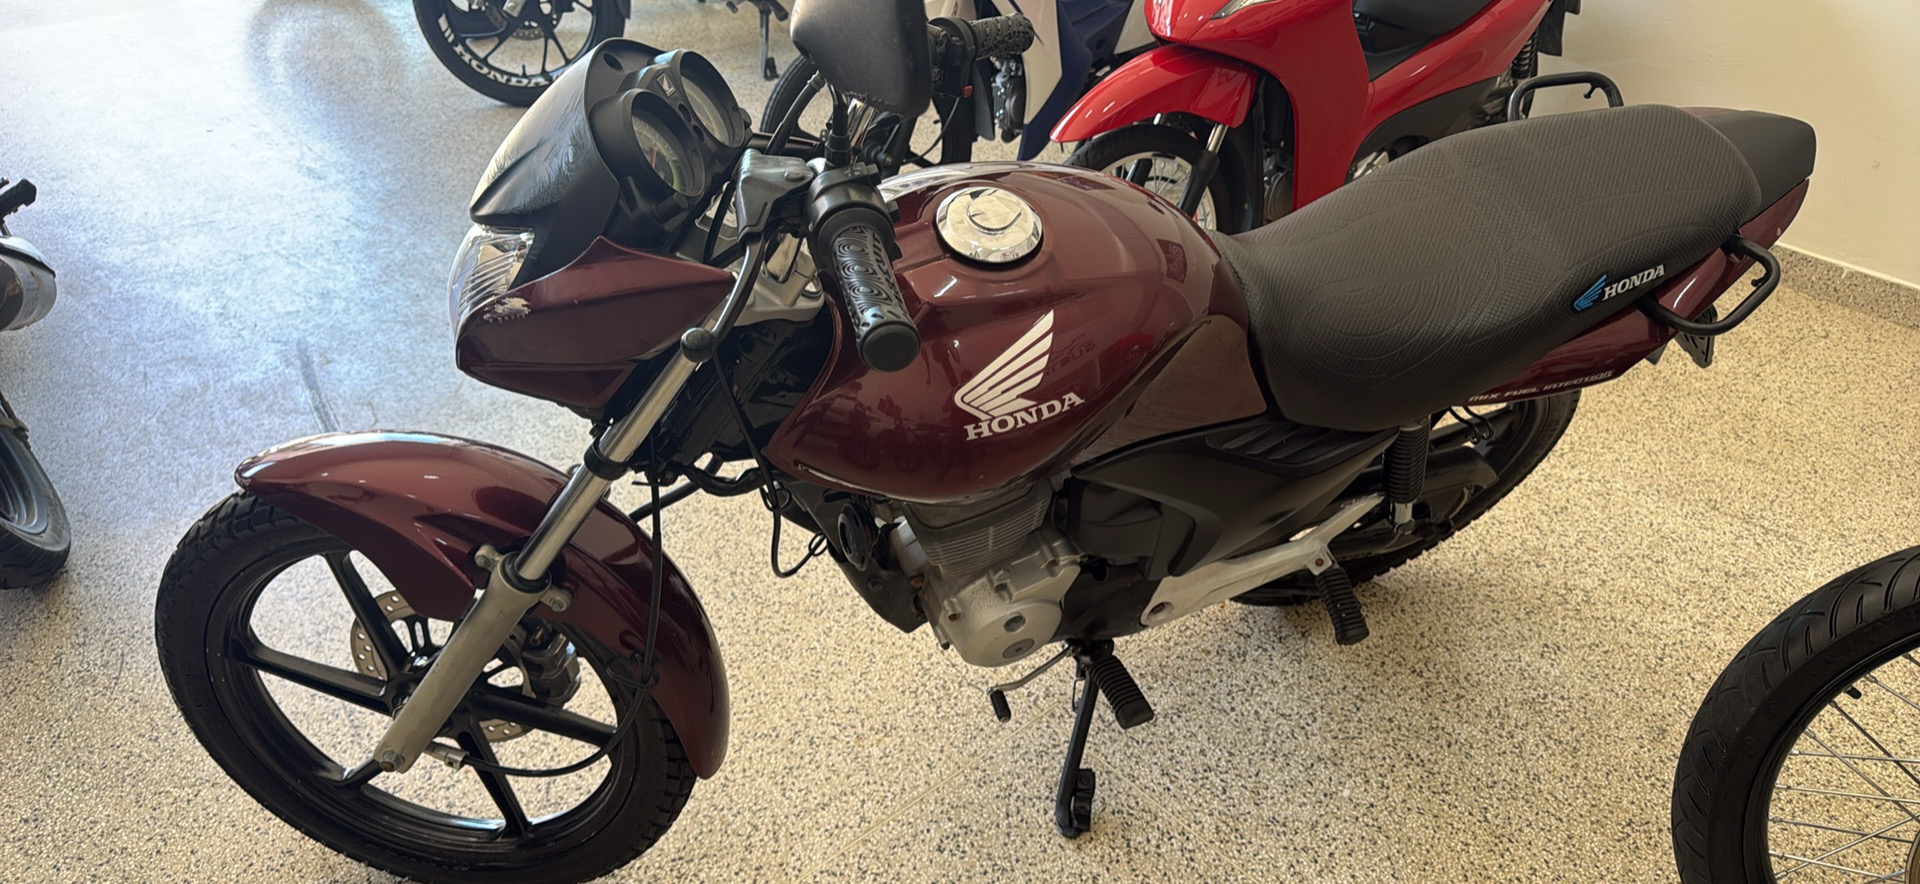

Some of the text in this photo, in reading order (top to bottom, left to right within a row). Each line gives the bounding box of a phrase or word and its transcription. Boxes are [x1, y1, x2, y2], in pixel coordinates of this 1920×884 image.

[453, 43, 549, 87] HONDA
[1603, 264, 1665, 300] HONDA
[1504, 387, 1539, 397] FUEL
[964, 392, 1085, 440] HONDA
